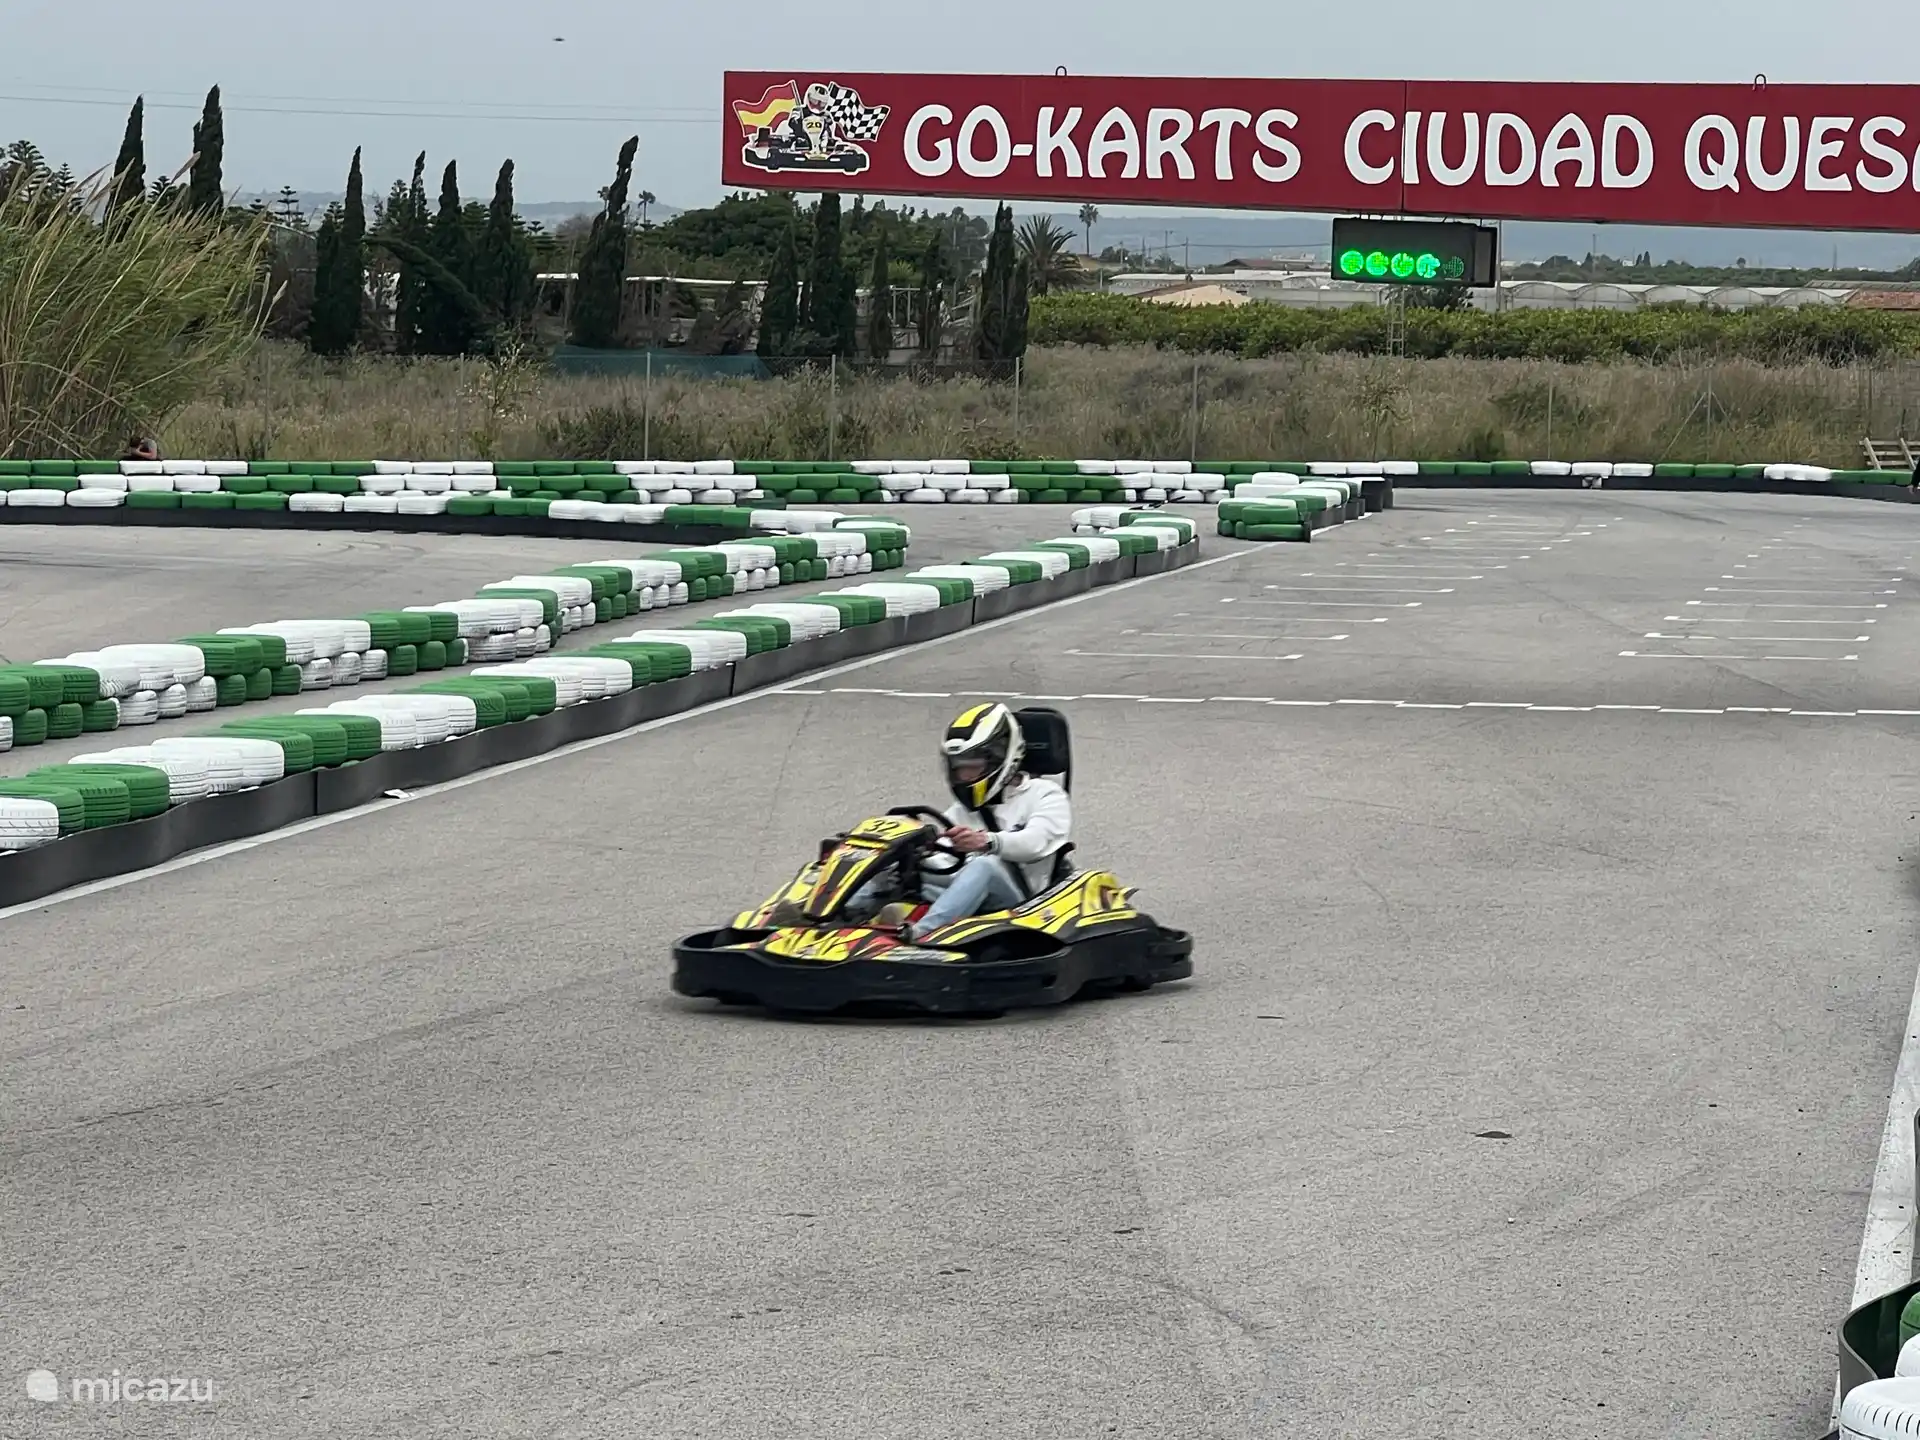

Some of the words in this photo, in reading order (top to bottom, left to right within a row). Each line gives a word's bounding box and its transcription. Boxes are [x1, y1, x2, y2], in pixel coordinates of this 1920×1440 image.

[806, 121, 822, 129] 20
[903, 104, 1301, 183] GO-KARTS
[1344, 109, 1654, 189] CIUDAD
[1684, 114, 1920, 194] QUES
[864, 819, 900, 833] 32
